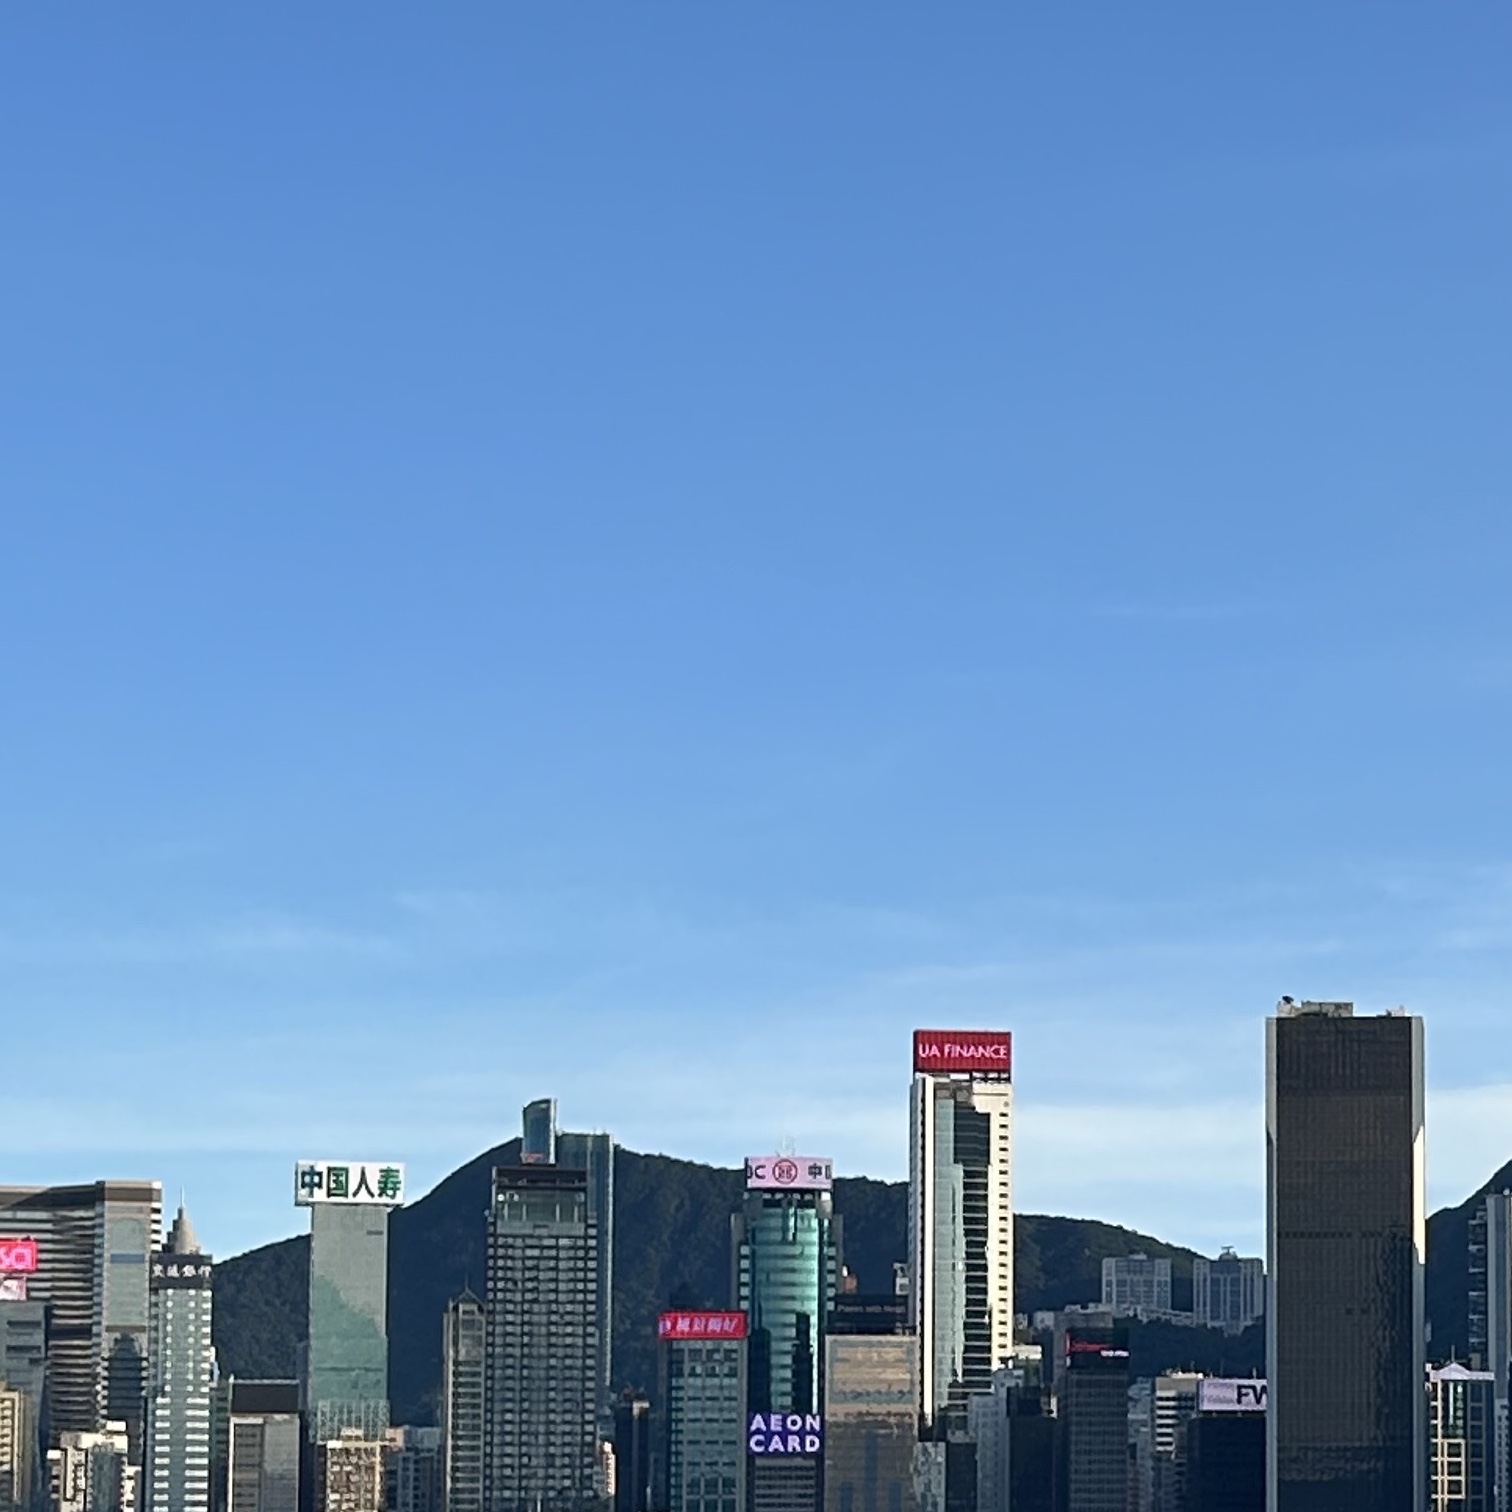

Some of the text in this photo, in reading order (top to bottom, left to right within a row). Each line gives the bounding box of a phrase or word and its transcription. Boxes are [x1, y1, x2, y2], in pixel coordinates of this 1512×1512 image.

[918, 1043, 1008, 1059] UA FINANCE
[300, 1165, 402, 1200] 中国人寿
[749, 1413, 821, 1432] AEON
[749, 1434, 821, 1453] CARD
